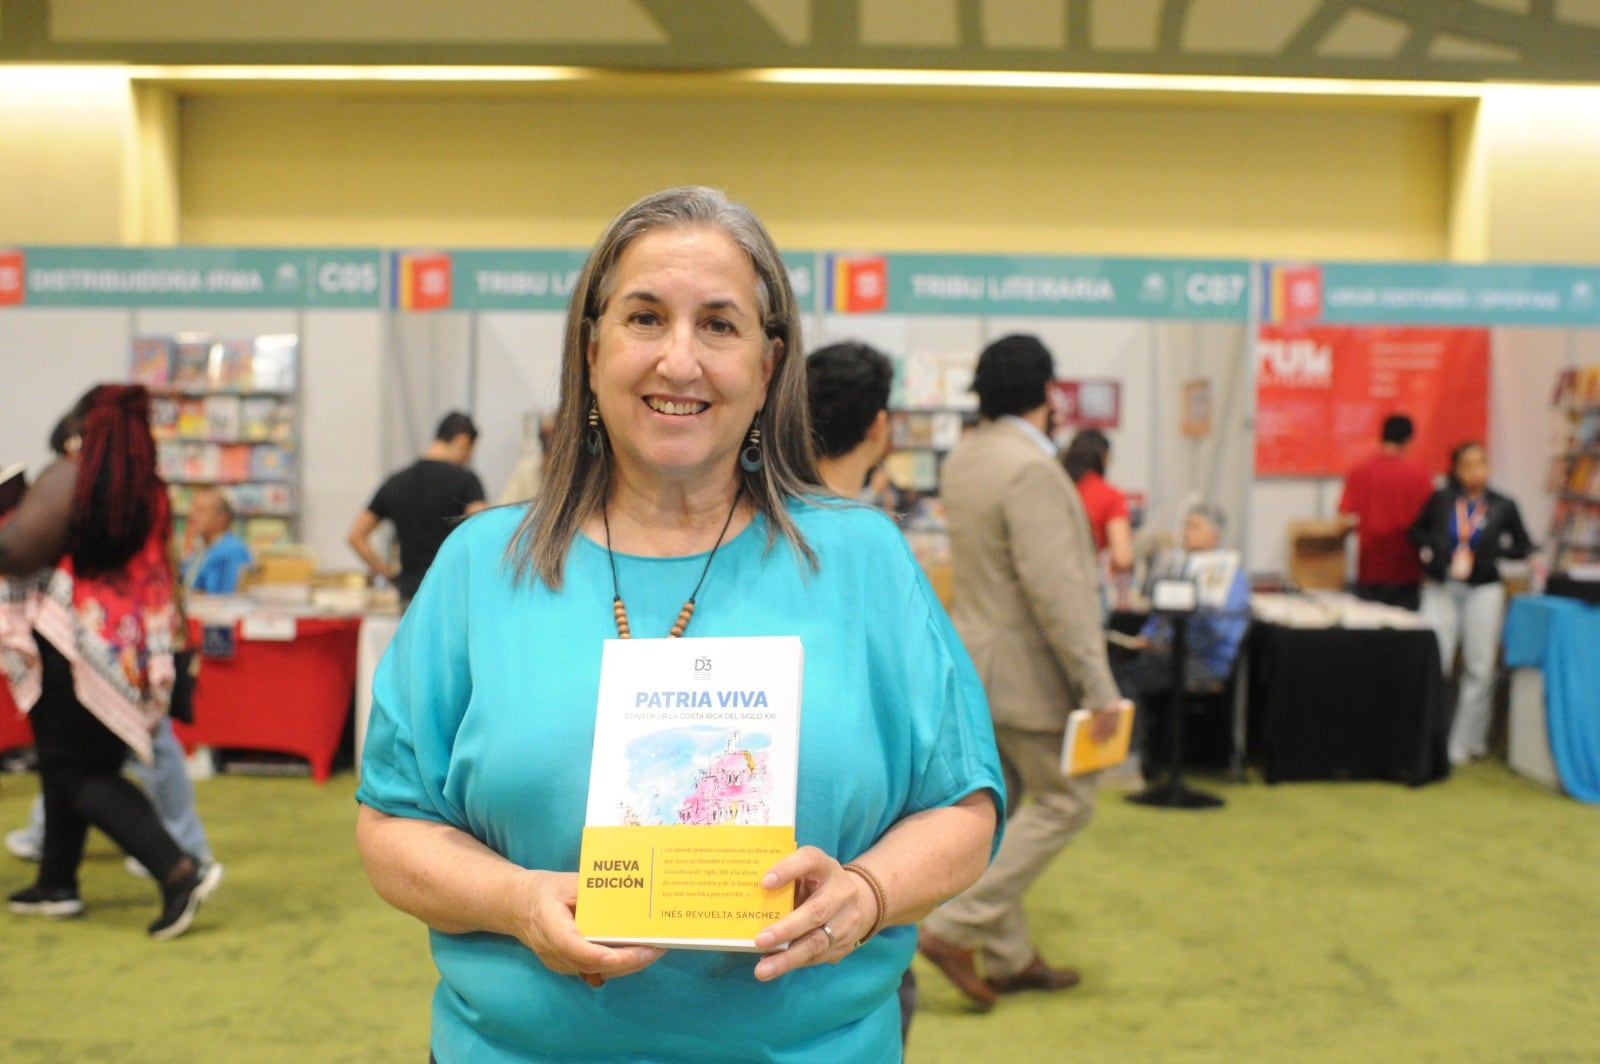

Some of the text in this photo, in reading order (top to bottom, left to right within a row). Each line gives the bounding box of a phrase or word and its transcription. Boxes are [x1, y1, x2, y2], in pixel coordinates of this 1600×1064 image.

[476, 269, 548, 295] TRIBU
[911, 273, 1114, 303] TRIBU LITERARIA
[635, 691, 769, 708] PATRIA VIVA
[624, 712, 667, 720] CONSTRUIR
[668, 712, 679, 720] LA
[680, 712, 705, 720] COSTA
[705, 712, 723, 720] RICA
[724, 712, 738, 720] DEL
[740, 712, 762, 720] SIGLO
[593, 860, 640, 872] NUEVA
[586, 875, 644, 888] EDICIÓN
[686, 910, 733, 919] REVUELTA
